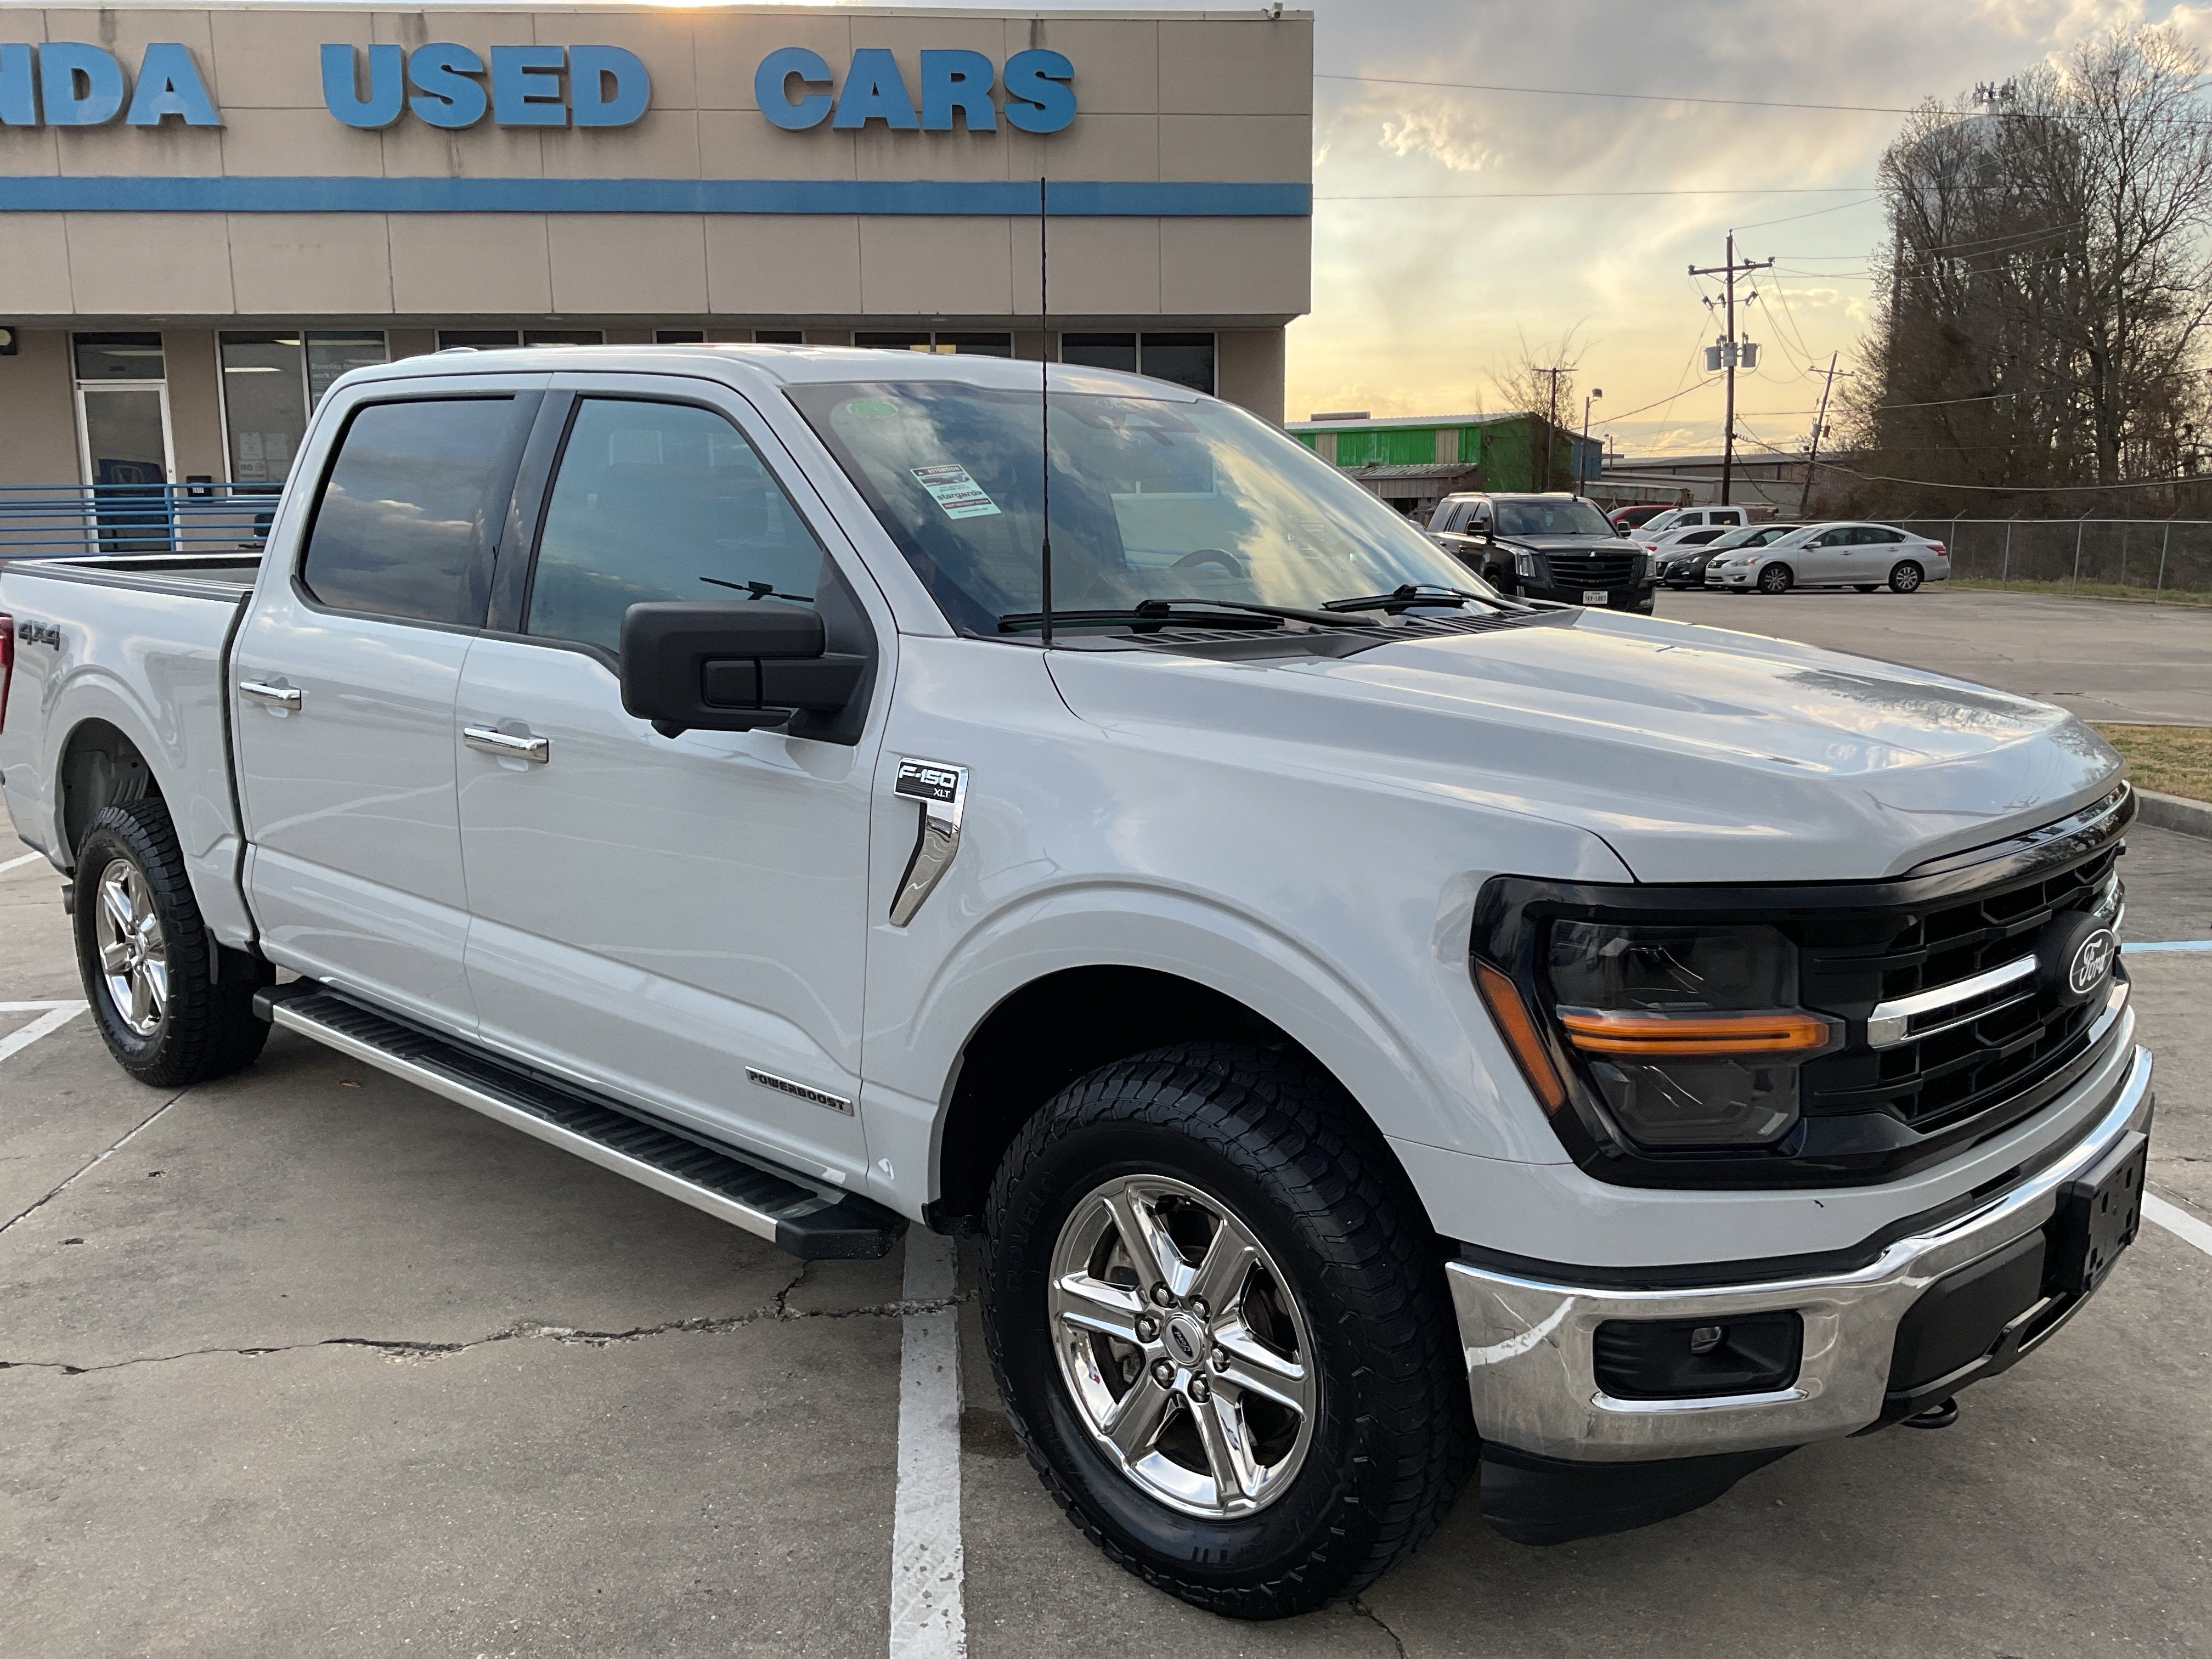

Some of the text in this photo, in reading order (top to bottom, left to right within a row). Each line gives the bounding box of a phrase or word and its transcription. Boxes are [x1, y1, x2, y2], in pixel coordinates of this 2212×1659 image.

[320, 42, 651, 129] USED
[754, 47, 1077, 134] CARS
[937, 490, 979, 500] stargard
[898, 765, 957, 788] F-150
[933, 788, 951, 799] XLT
[2079, 938, 2109, 986] Ford
[749, 1070, 845, 1111] POWERBOOST
